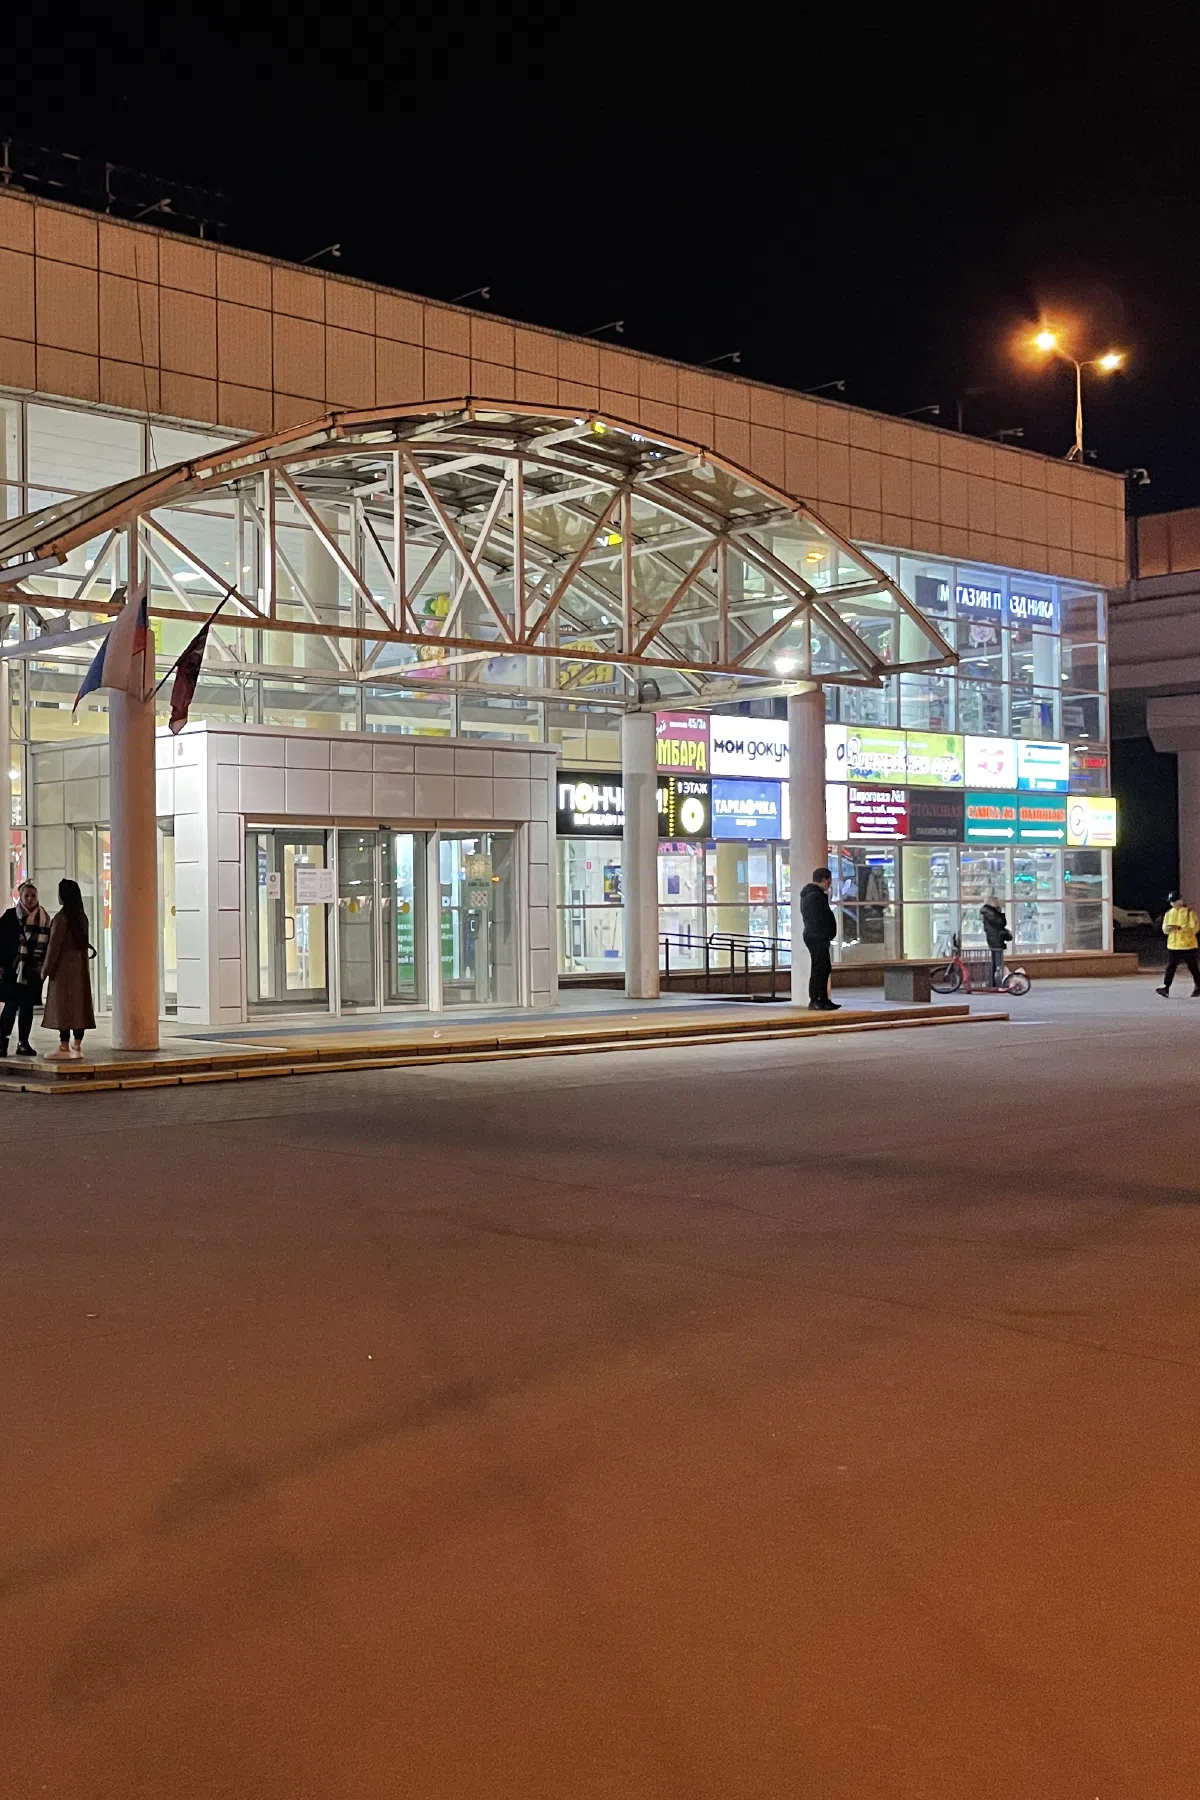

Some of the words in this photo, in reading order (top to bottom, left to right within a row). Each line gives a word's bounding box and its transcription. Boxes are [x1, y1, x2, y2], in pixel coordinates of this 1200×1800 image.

[940, 583, 991, 608] МГАЗИН
[994, 592, 1054, 619] ПЗДНИКА
[656, 739, 707, 771] МБАРД
[683, 782, 708, 795] ЭТАЖ
